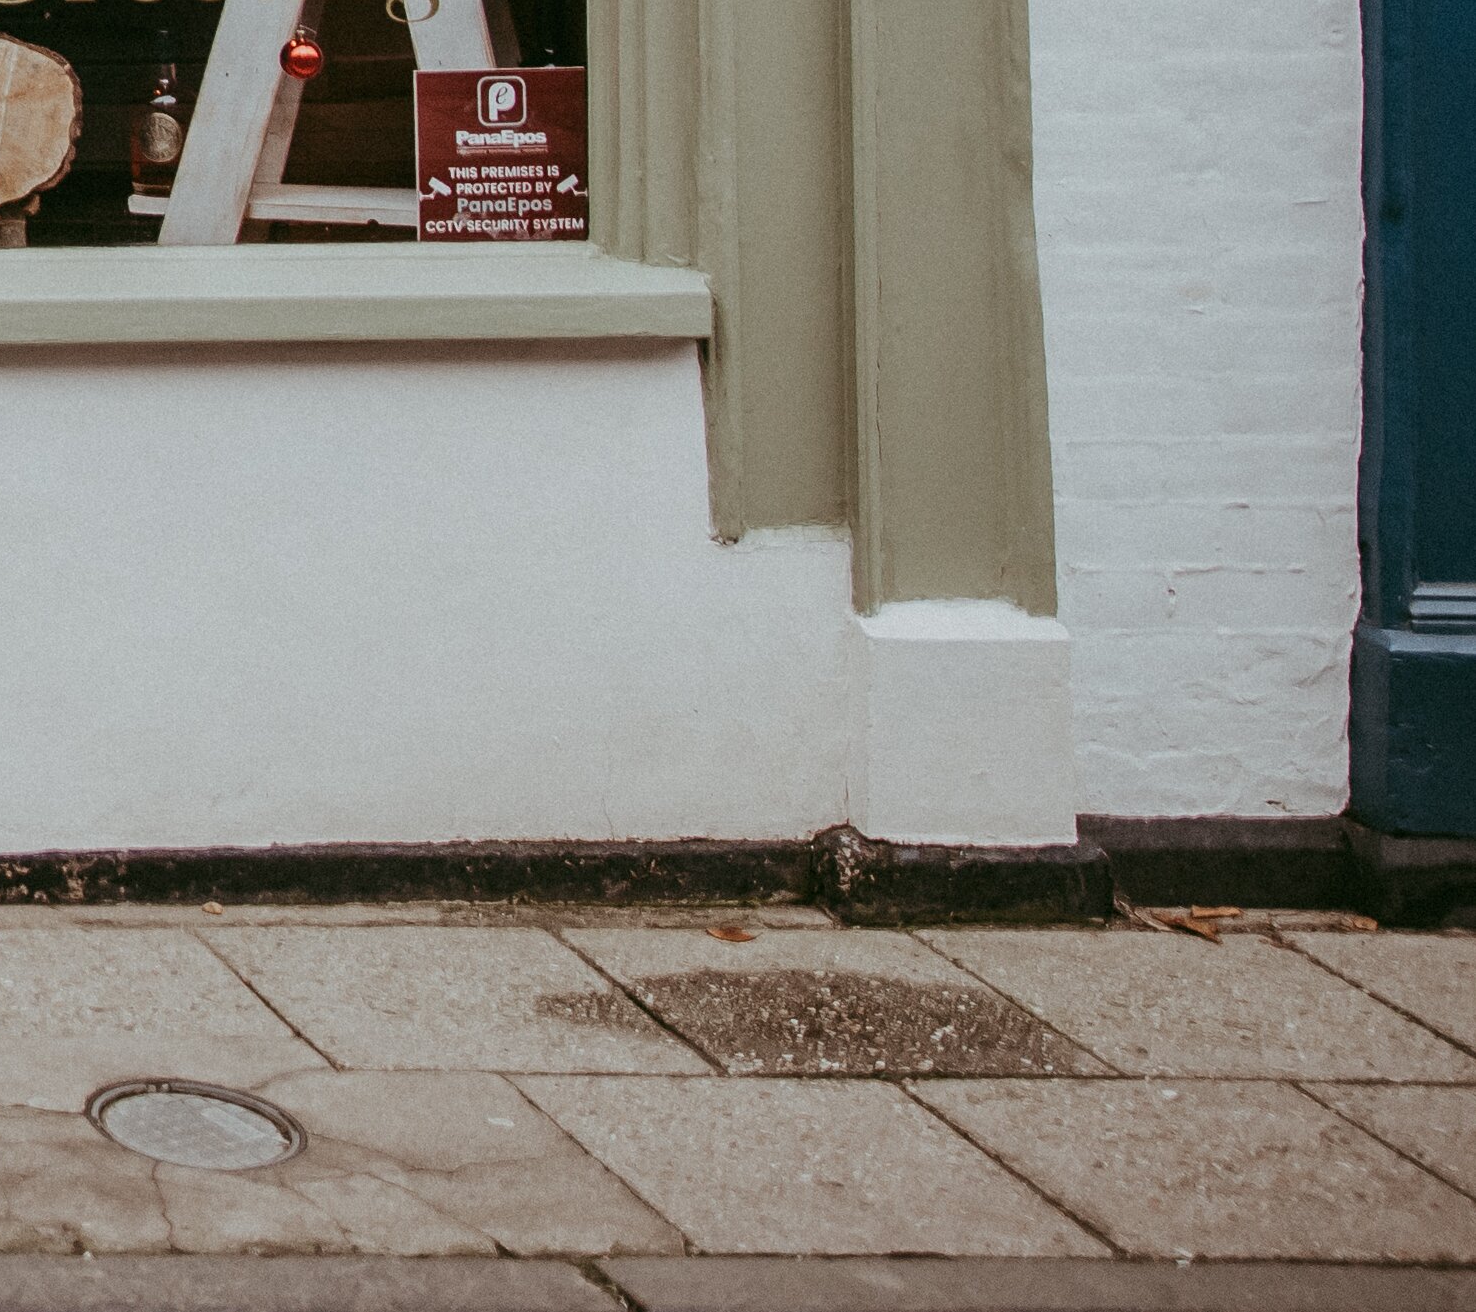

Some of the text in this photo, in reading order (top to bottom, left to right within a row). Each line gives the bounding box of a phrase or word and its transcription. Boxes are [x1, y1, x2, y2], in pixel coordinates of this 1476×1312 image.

[455, 130, 547, 148] PanaEpos
[448, 165, 560, 179] THIS PREMISES IS
[456, 181, 552, 195] PROTECTED BY
[457, 197, 553, 216] PanaEpos
[425, 217, 584, 233] CCTV SECURITY SYSTEM
